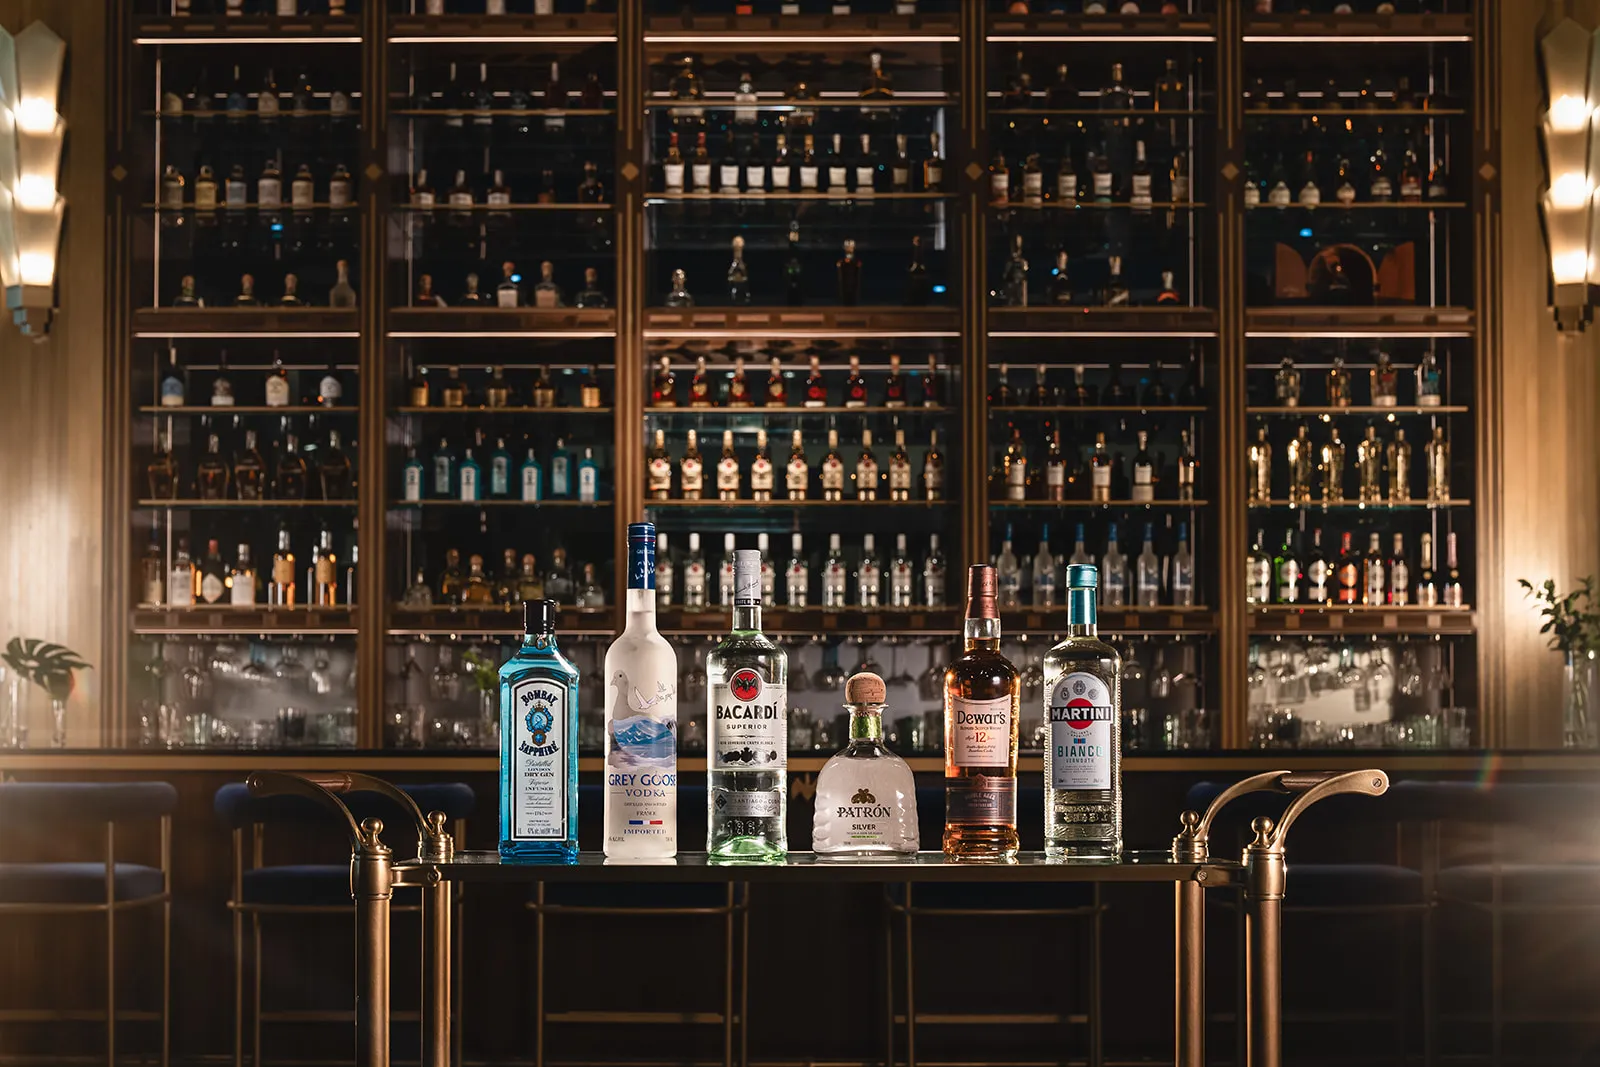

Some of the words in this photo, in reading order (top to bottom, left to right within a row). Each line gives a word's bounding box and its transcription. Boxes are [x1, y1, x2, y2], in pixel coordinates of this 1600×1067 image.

[520, 689, 558, 706] BOMBAY
[716, 701, 778, 719] BACARDÍ
[1051, 707, 1110, 720] MARTINI
[957, 711, 1006, 725] Dewar's
[975, 732, 986, 742] 12
[519, 741, 559, 757] SAPPHIRE
[1058, 746, 1104, 757] BIANCO
[608, 774, 637, 786] GREY
[626, 789, 666, 797] VODKA
[837, 804, 891, 818] PATRÓN
